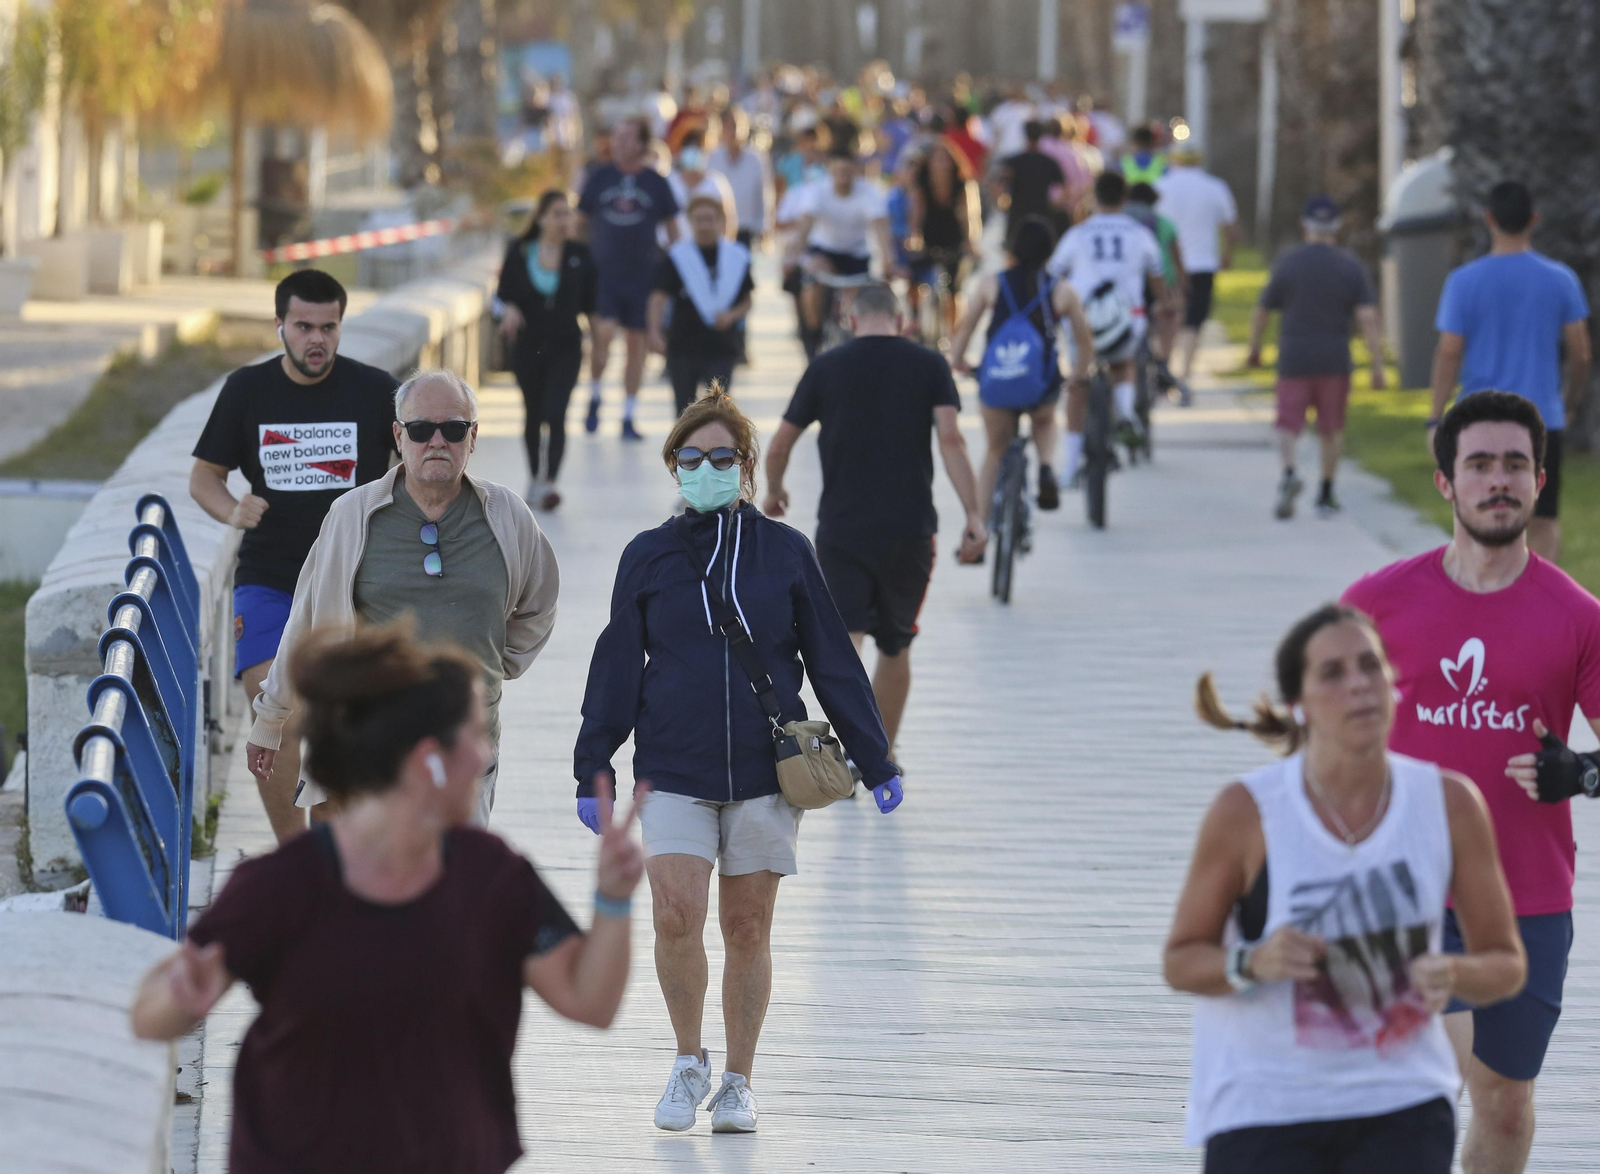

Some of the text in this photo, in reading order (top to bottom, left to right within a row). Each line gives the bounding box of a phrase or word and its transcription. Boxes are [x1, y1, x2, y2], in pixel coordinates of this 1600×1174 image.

[1093, 235, 1122, 261] 11
[294, 427, 351, 439] balance
[264, 443, 351, 461] new balance
[267, 463, 291, 475] new
[1416, 697, 1530, 732] maristas
